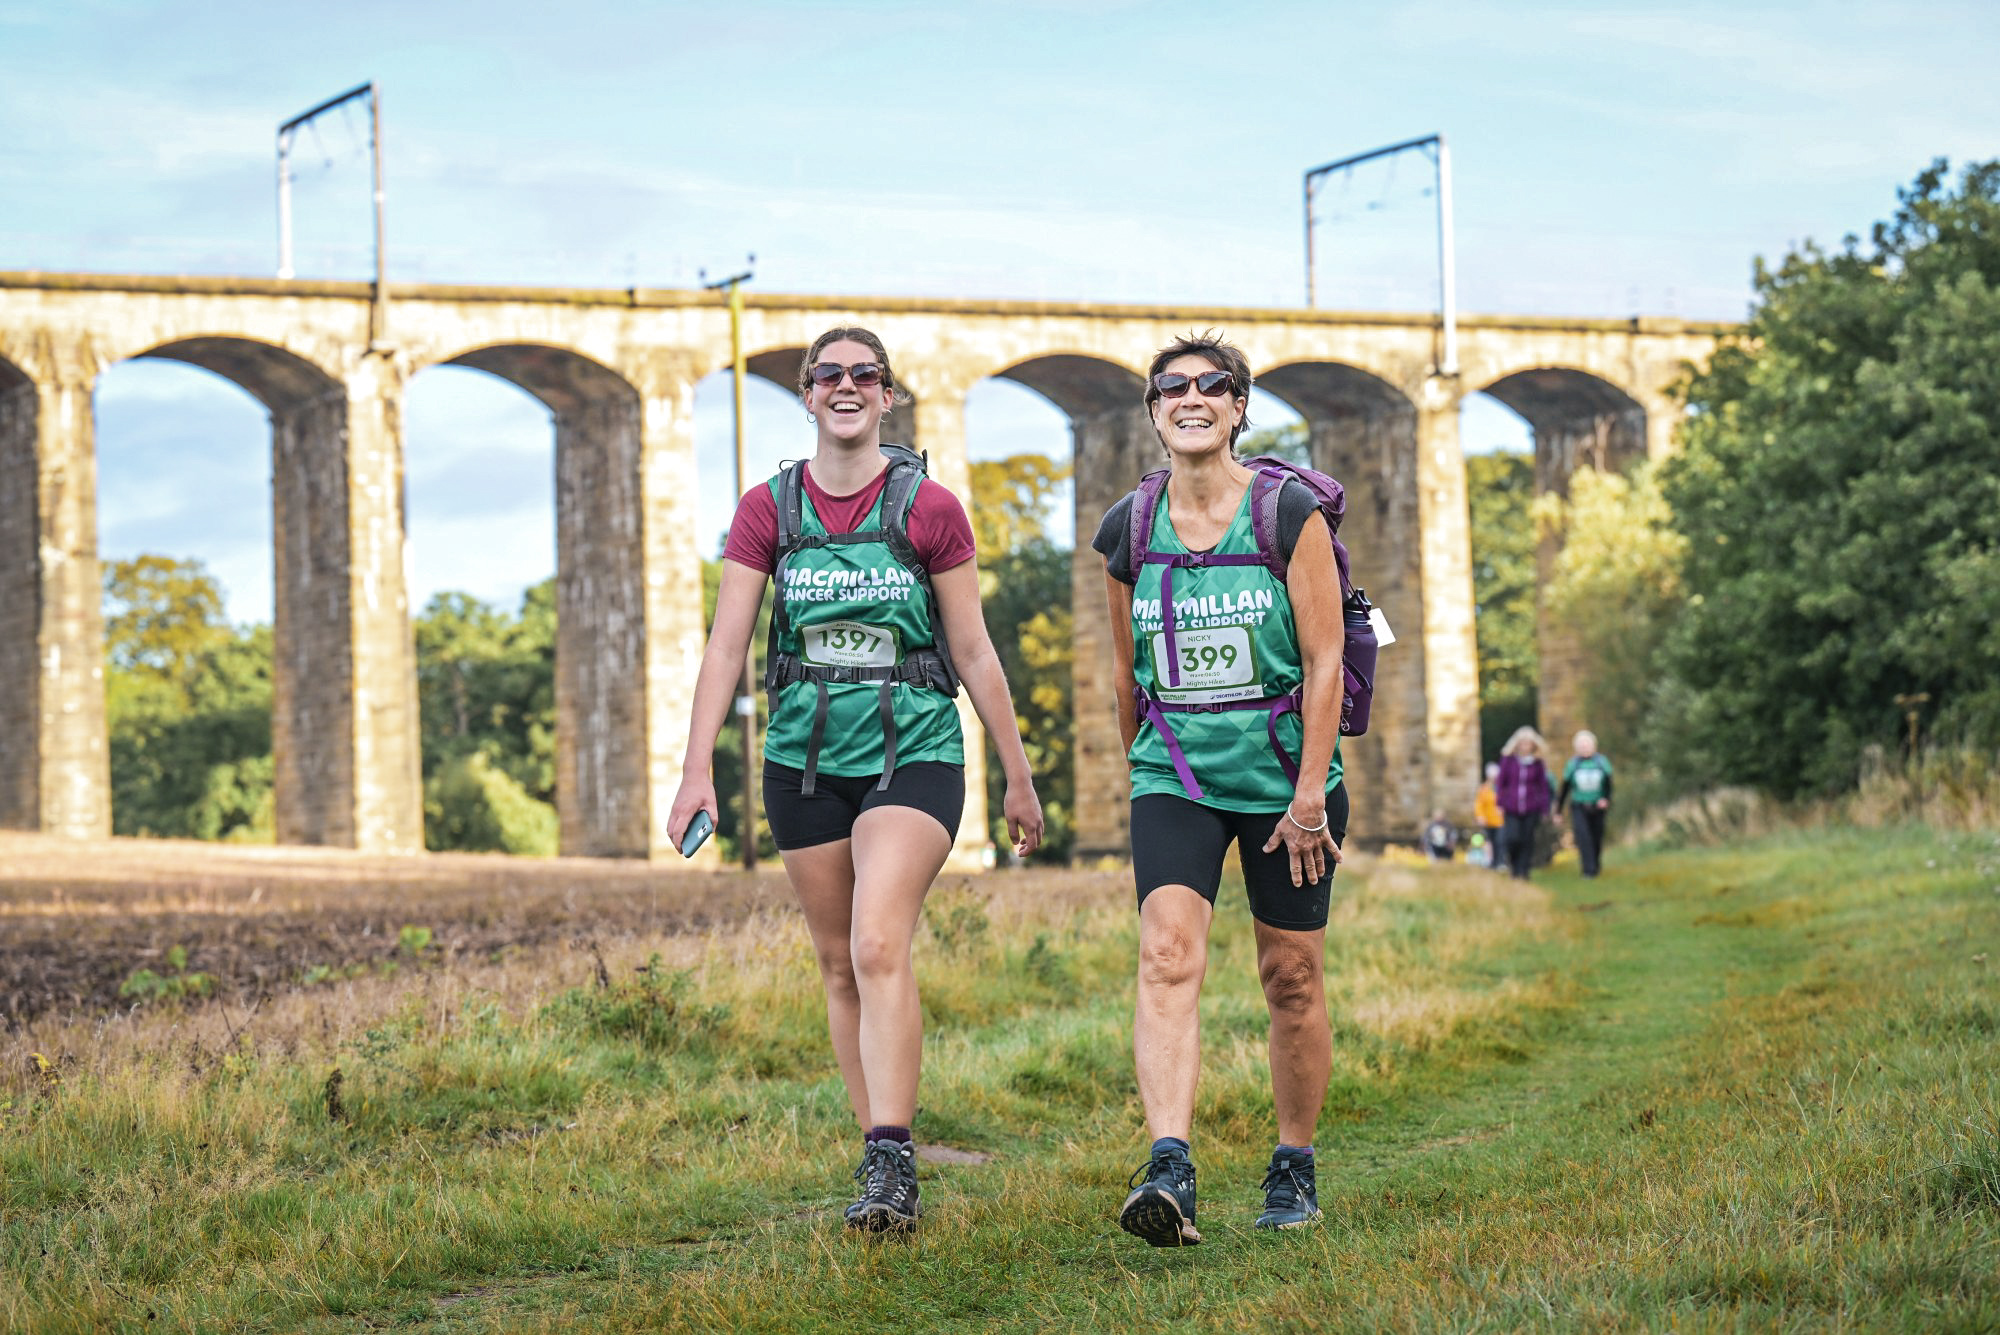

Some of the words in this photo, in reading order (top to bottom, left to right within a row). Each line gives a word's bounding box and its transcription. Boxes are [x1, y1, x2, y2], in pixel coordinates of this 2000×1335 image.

[784, 567, 915, 588] MACMILLAN
[838, 587, 911, 602] SUPPORT
[817, 628, 882, 653] 1397
[1187, 634, 1212, 643] NICKY
[830, 658, 850, 666] Mighty
[1180, 644, 1238, 672] 399
[1186, 680, 1207, 688] Mighty
